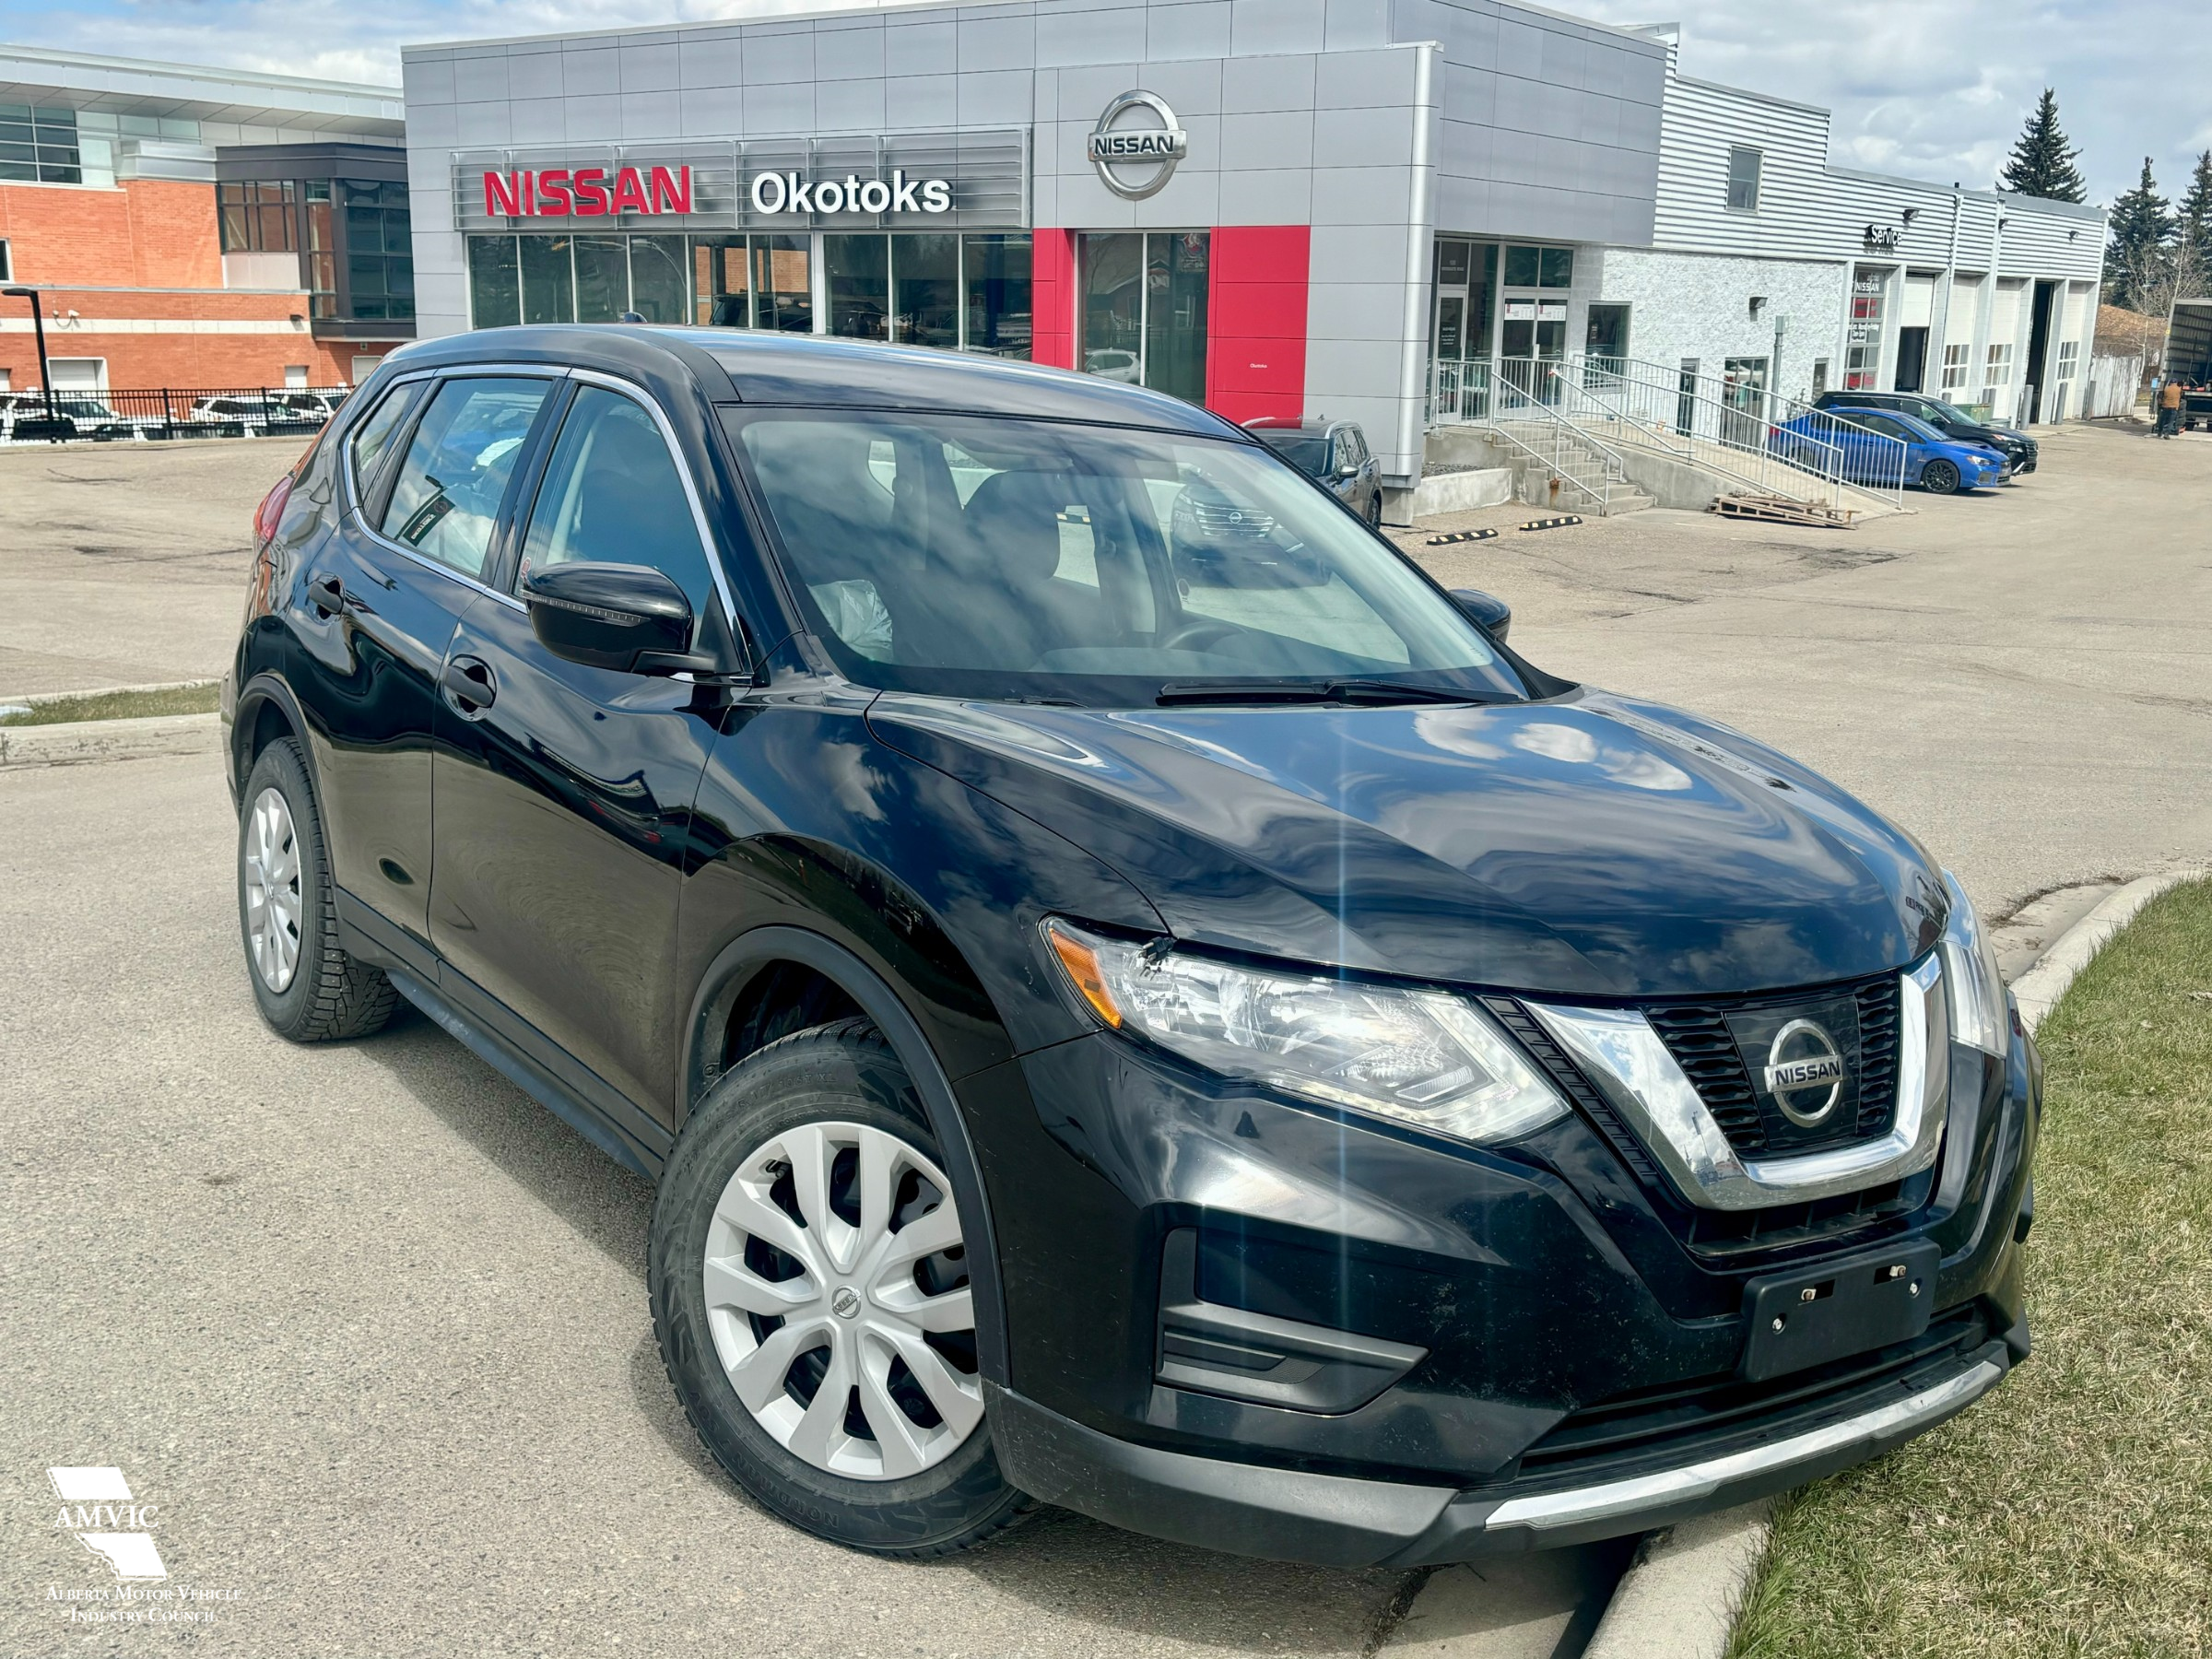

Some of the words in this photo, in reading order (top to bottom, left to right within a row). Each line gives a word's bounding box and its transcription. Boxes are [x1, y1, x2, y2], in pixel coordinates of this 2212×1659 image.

[1094, 135, 1174, 155] NISSAN
[483, 165, 695, 218] NISSAN
[751, 170, 953, 214] Okotoks
[1871, 224, 1902, 246] Service
[1775, 1060, 1841, 1087] NISSAN
